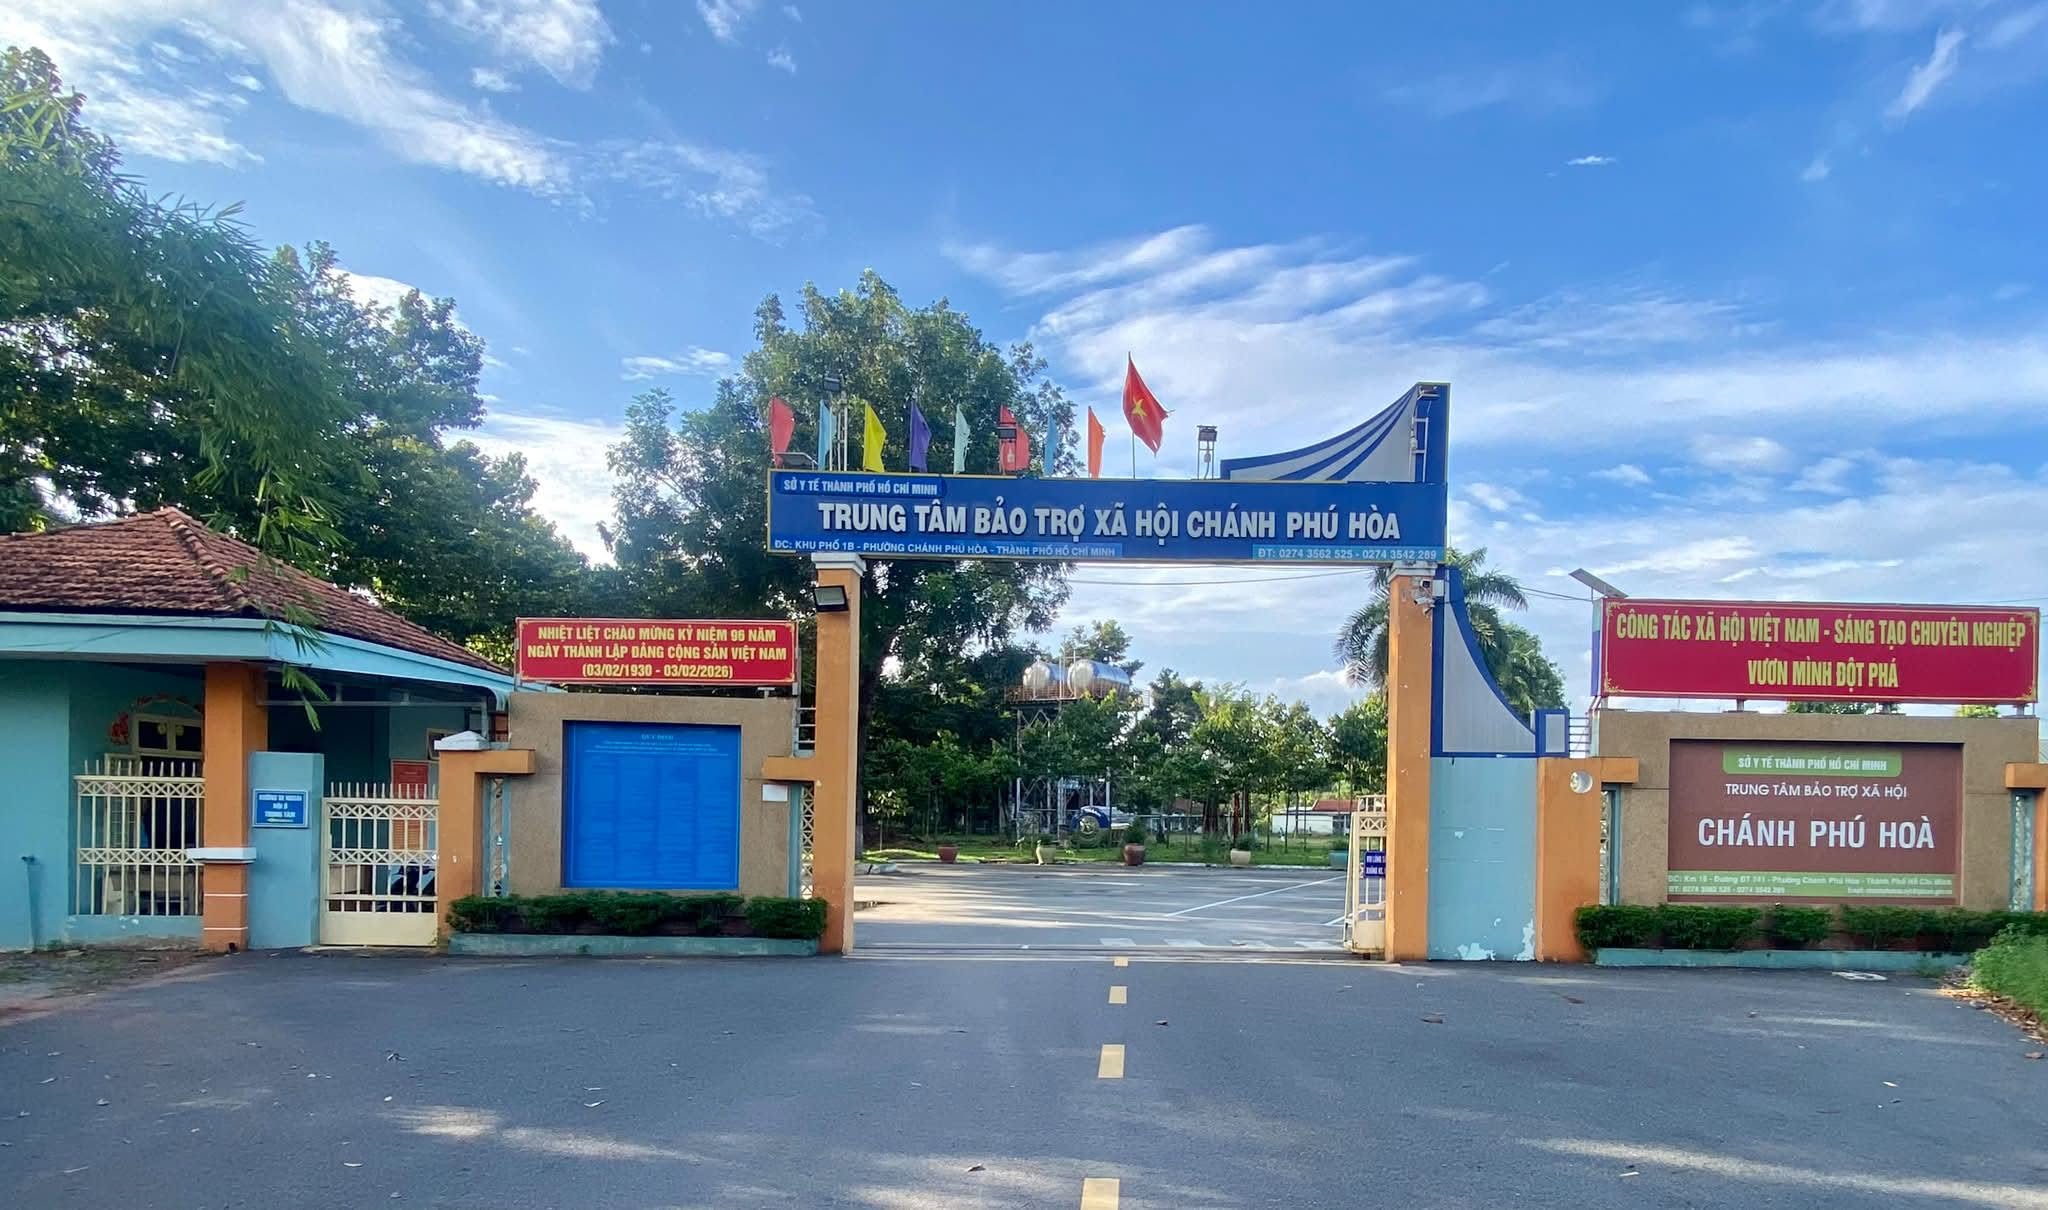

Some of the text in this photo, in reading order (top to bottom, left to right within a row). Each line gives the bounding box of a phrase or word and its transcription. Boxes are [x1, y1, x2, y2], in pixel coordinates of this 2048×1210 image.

[784, 477, 797, 491] SỞ
[799, 480, 805, 491] Y
[808, 477, 820, 491] TẾ
[855, 479, 876, 493] PHỐ
[893, 482, 909, 494] CHÍ
[911, 483, 938, 495] MINH
[818, 496, 1400, 546] TRUNG TÂM BẢO TRỢ XÃ HỘI CHÁNH PHÚ HÒA
[775, 540, 792, 549] ĐC:
[795, 541, 816, 550] KHU
[819, 539, 840, 550] PHỐ
[843, 542, 855, 551] 1B
[863, 541, 905, 552] PHƯỜNG
[908, 541, 942, 553] CHÁNH
[996, 543, 1030, 555] THÀNH
[1033, 544, 1053, 555] PHỐ
[1071, 545, 1089, 556] CHÍ
[1091, 547, 1116, 556] MINH
[1258, 548, 1275, 558] ĐT:
[1279, 548, 1304, 558] 0274
[1334, 549, 1353, 559] 525
[1362, 549, 1387, 559] 0274
[538, 624, 574, 642] NHIỆT
[576, 624, 601, 643] LIỆT
[603, 625, 636, 640] CHÀO
[639, 625, 675, 641] MỪNG
[678, 624, 693, 641] KỶ
[696, 626, 727, 644] NIỆM
[748, 627, 776, 642] NĂM
[1616, 608, 1658, 640] CÔNG
[1663, 609, 1691, 640] TÁC
[1695, 611, 1716, 641] XÃ
[1719, 611, 1745, 647] HỘI
[1749, 611, 1781, 648] VIỆT
[1784, 617, 1820, 643] NAM
[1834, 613, 1875, 645] SÁNG
[1878, 619, 1907, 651] TẠO
[1910, 616, 1969, 647] CHUYÊN
[1972, 617, 2026, 653] NGHIỆP
[527, 641, 787, 663] NGÀY THÀNH LẬP ĐẢNG CỘNG SẢN VIỆT NAM
[582, 663, 653, 678] (03/02/1930
[663, 664, 734, 679] 03/02/2026)
[1747, 655, 1899, 692] VƯƠN MÌNH ĐỘT PHÁ
[1738, 754, 1751, 768] SỞ
[1753, 757, 1760, 768] Y
[1761, 755, 1773, 769] TẾ
[1725, 780, 1907, 801] TRUNG TÂM BẢO TRỢ XÃ HỘI
[1698, 813, 1935, 849] CHÁNH PHÚ HOÀ
